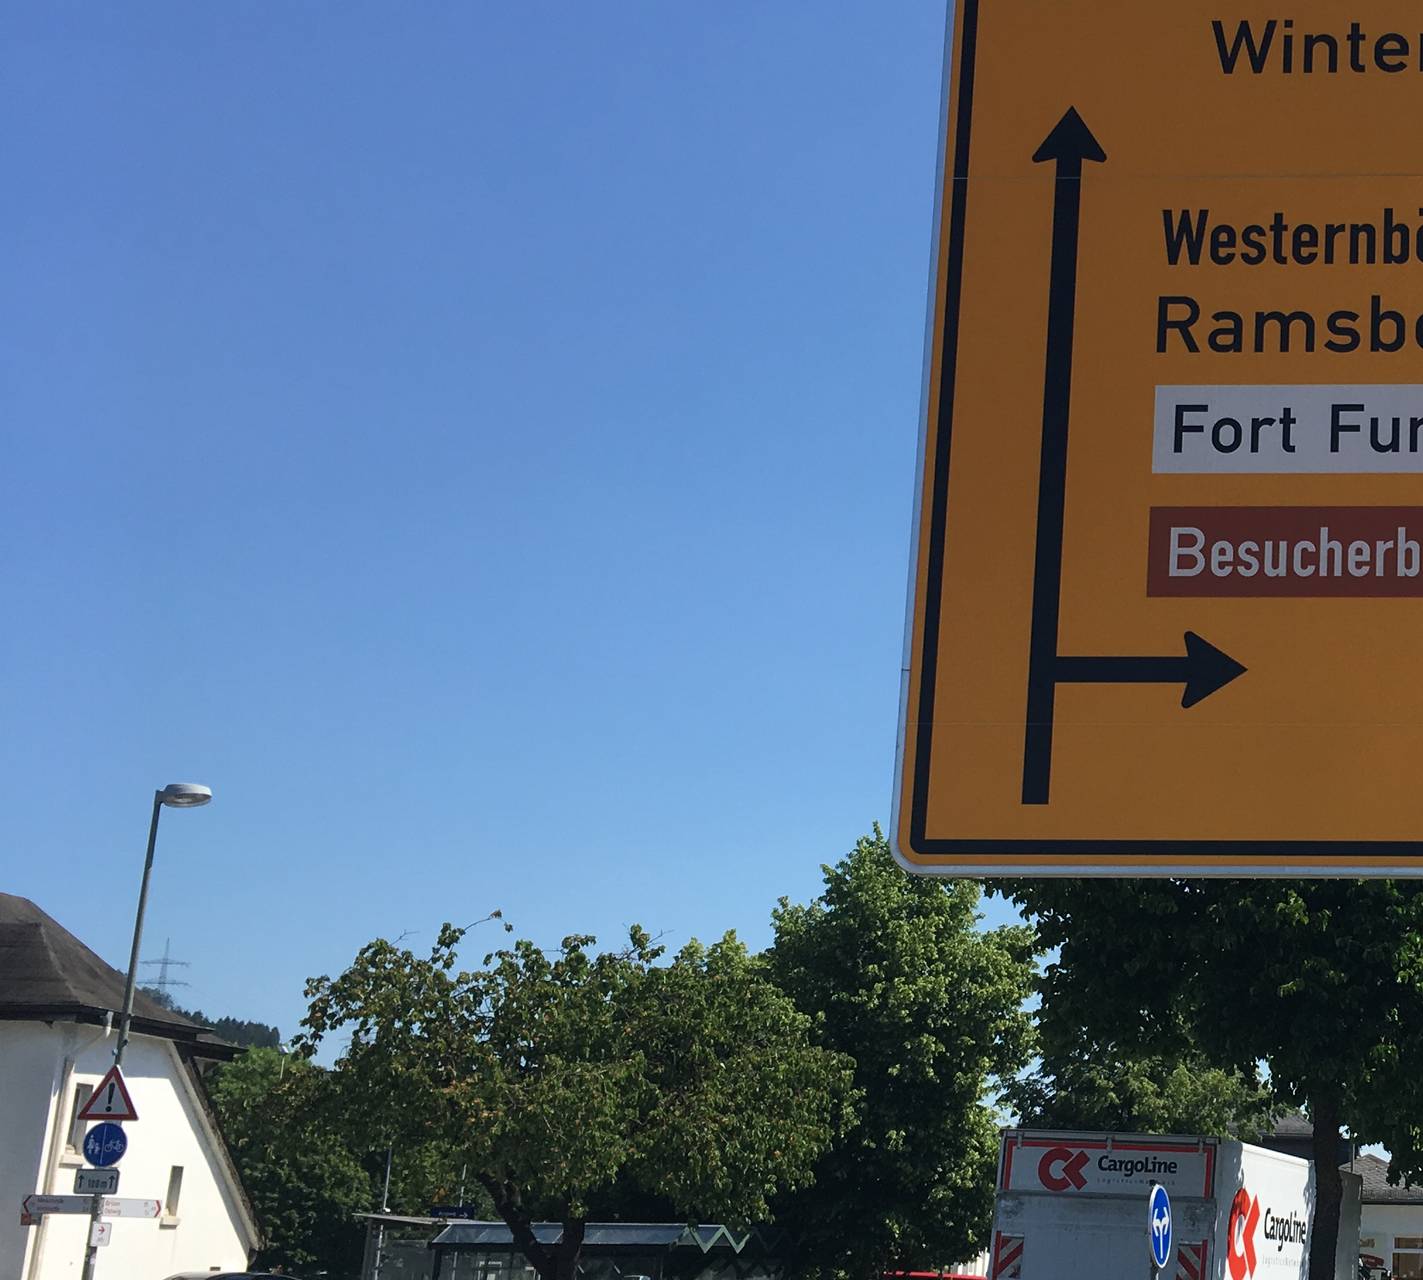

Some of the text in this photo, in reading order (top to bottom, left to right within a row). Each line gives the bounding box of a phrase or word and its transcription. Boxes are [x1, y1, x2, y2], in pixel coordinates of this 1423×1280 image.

[1173, 404, 1297, 454] Fort
[1097, 1154, 1178, 1178] CargoLine
[1264, 1207, 1306, 1252] CargoLine
